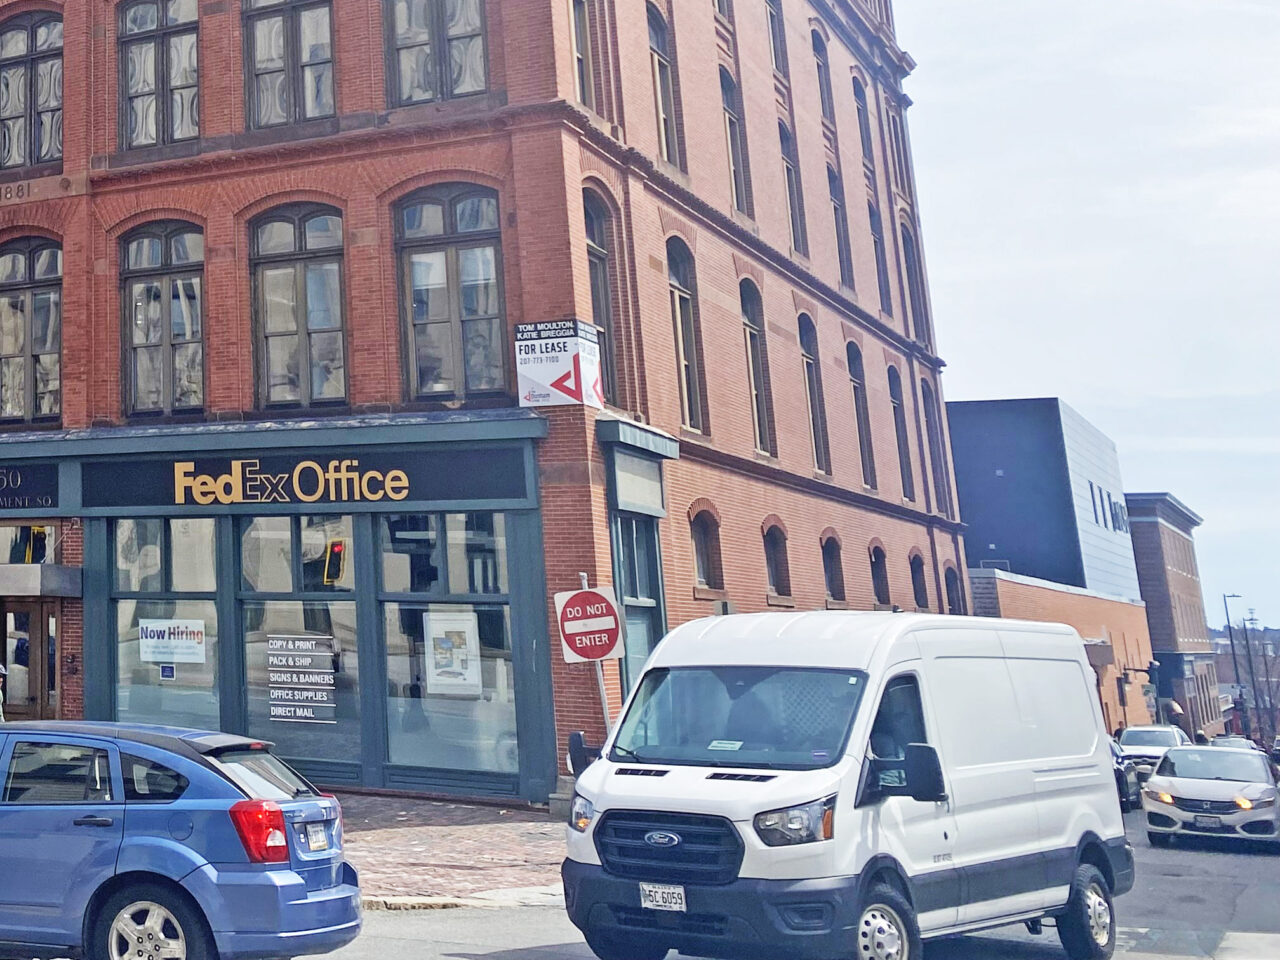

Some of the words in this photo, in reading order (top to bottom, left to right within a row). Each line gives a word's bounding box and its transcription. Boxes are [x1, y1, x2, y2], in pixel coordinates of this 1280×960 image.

[517, 324, 534, 332] TOM
[517, 331, 538, 339] KATIE
[541, 328, 574, 338] BREGGIA
[519, 343, 536, 355] FOR
[540, 341, 568, 353] LEASE
[174, 459, 290, 505] FedEx
[292, 459, 410, 502] Office
[566, 606, 582, 618] DO
[586, 603, 607, 615] NOT
[140, 626, 165, 640] Now
[168, 626, 203, 644] Hiring
[575, 633, 609, 648] ENTER
[268, 640, 287, 649] COPY
[288, 641, 294, 649] &
[295, 641, 316, 650] PRINT
[269, 656, 287, 665] PACK
[288, 657, 294, 665] &
[295, 657, 312, 666] SHIP
[269, 673, 291, 682] SIGNS
[292, 673, 299, 682] &
[300, 674, 334, 684] BANNERS
[270, 690, 293, 700] OFFICE
[294, 691, 328, 701] SUPPLIES
[270, 706, 295, 716] DIRECT
[296, 708, 314, 717] MAIL
[661, 891, 683, 906] 6059
